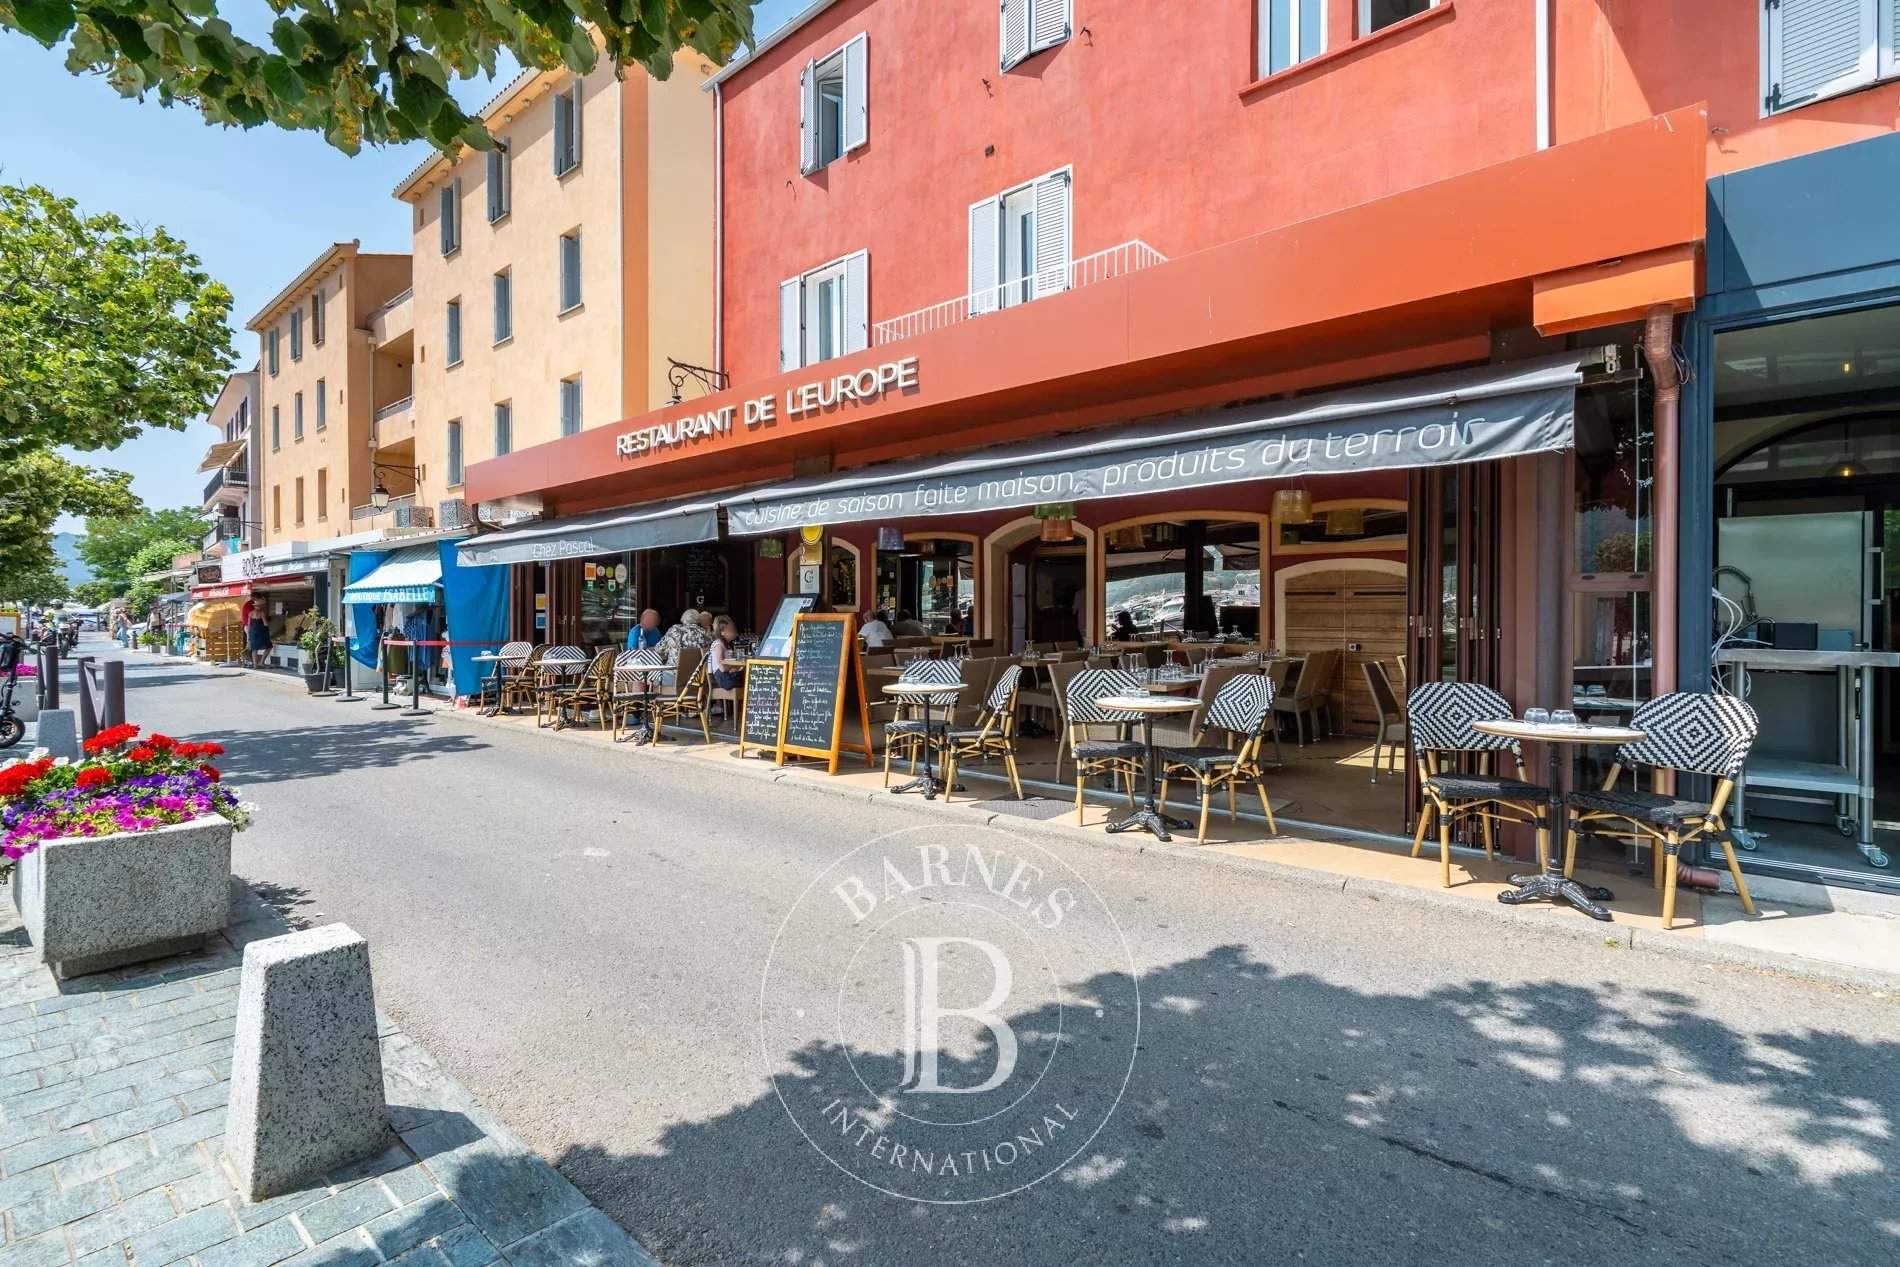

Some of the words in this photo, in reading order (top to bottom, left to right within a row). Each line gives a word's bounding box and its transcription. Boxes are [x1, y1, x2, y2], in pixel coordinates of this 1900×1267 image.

[616, 405, 737, 455] RESTAURANT
[744, 395, 777, 425] DE
[786, 356, 919, 415] L'EUROPE
[745, 501, 801, 526] cuisine
[807, 498, 830, 519] de
[837, 491, 903, 515] saison
[914, 482, 966, 508] faite
[1102, 446, 1246, 493] produits
[1261, 434, 1313, 465] du
[1324, 411, 1487, 459] terroir
[383, 587, 429, 602] ISABELLE
